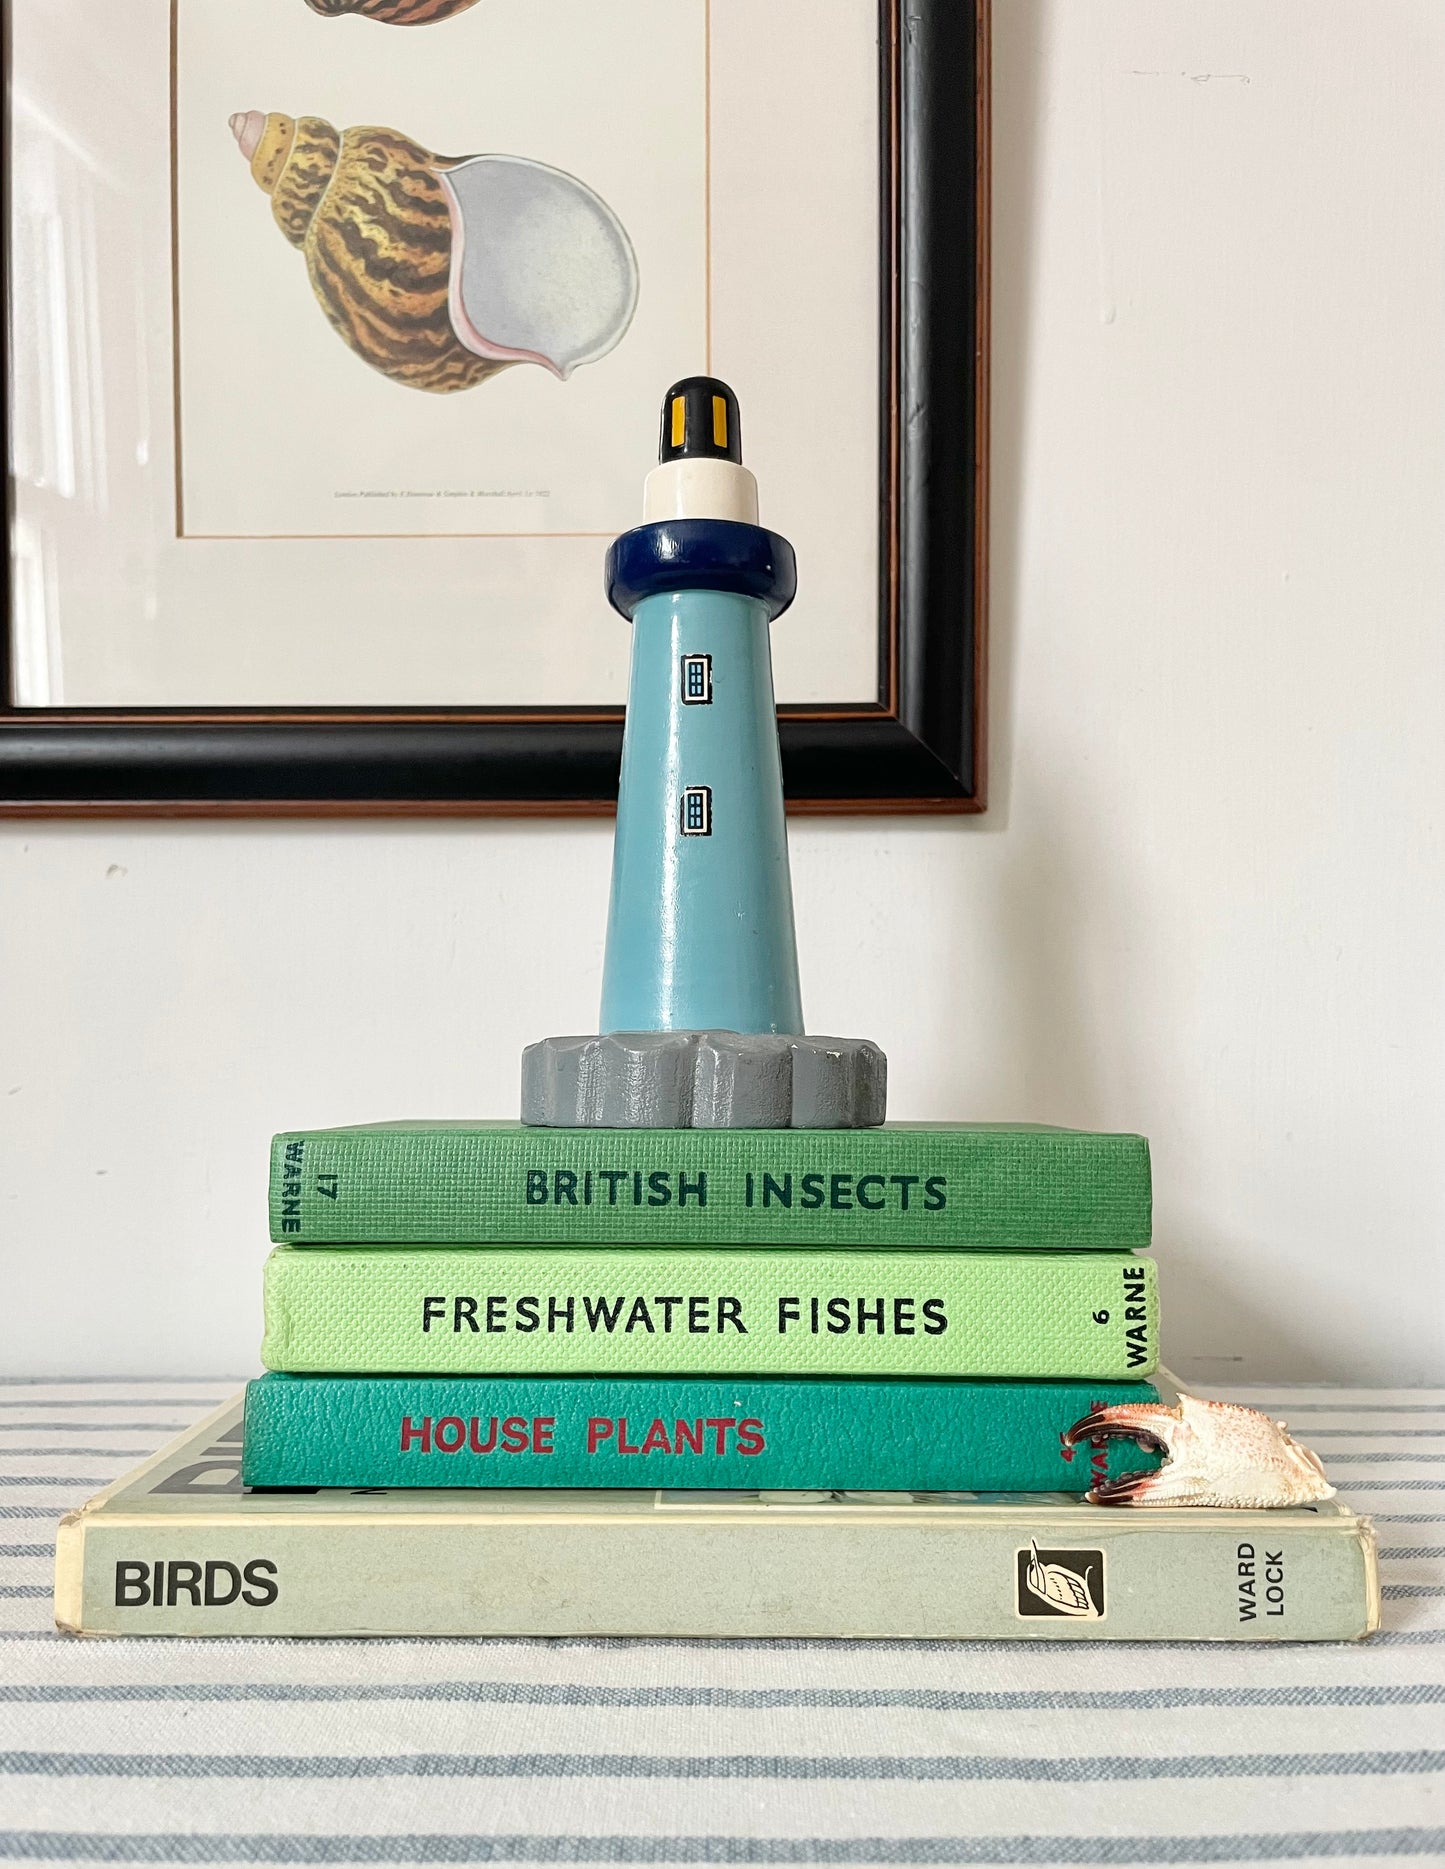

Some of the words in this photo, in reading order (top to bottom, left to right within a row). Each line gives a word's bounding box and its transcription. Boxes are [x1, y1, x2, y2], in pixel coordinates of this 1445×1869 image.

[281, 1139, 305, 1233] WARNE
[316, 1173, 339, 1201] 17
[526, 1169, 708, 1207] BRITISH
[744, 1172, 948, 1211] INSECTS
[422, 1296, 748, 1334] FRESHWATER
[777, 1296, 949, 1336] FISHES
[1092, 1309, 1110, 1325] 6
[1122, 1266, 1148, 1369] WARNE
[400, 1416, 555, 1455] HOUSE
[586, 1417, 766, 1457] PLANTS
[114, 1558, 279, 1607] BIRDS
[1237, 1542, 1257, 1623] WARD
[1265, 1549, 1285, 1617] LOCK
